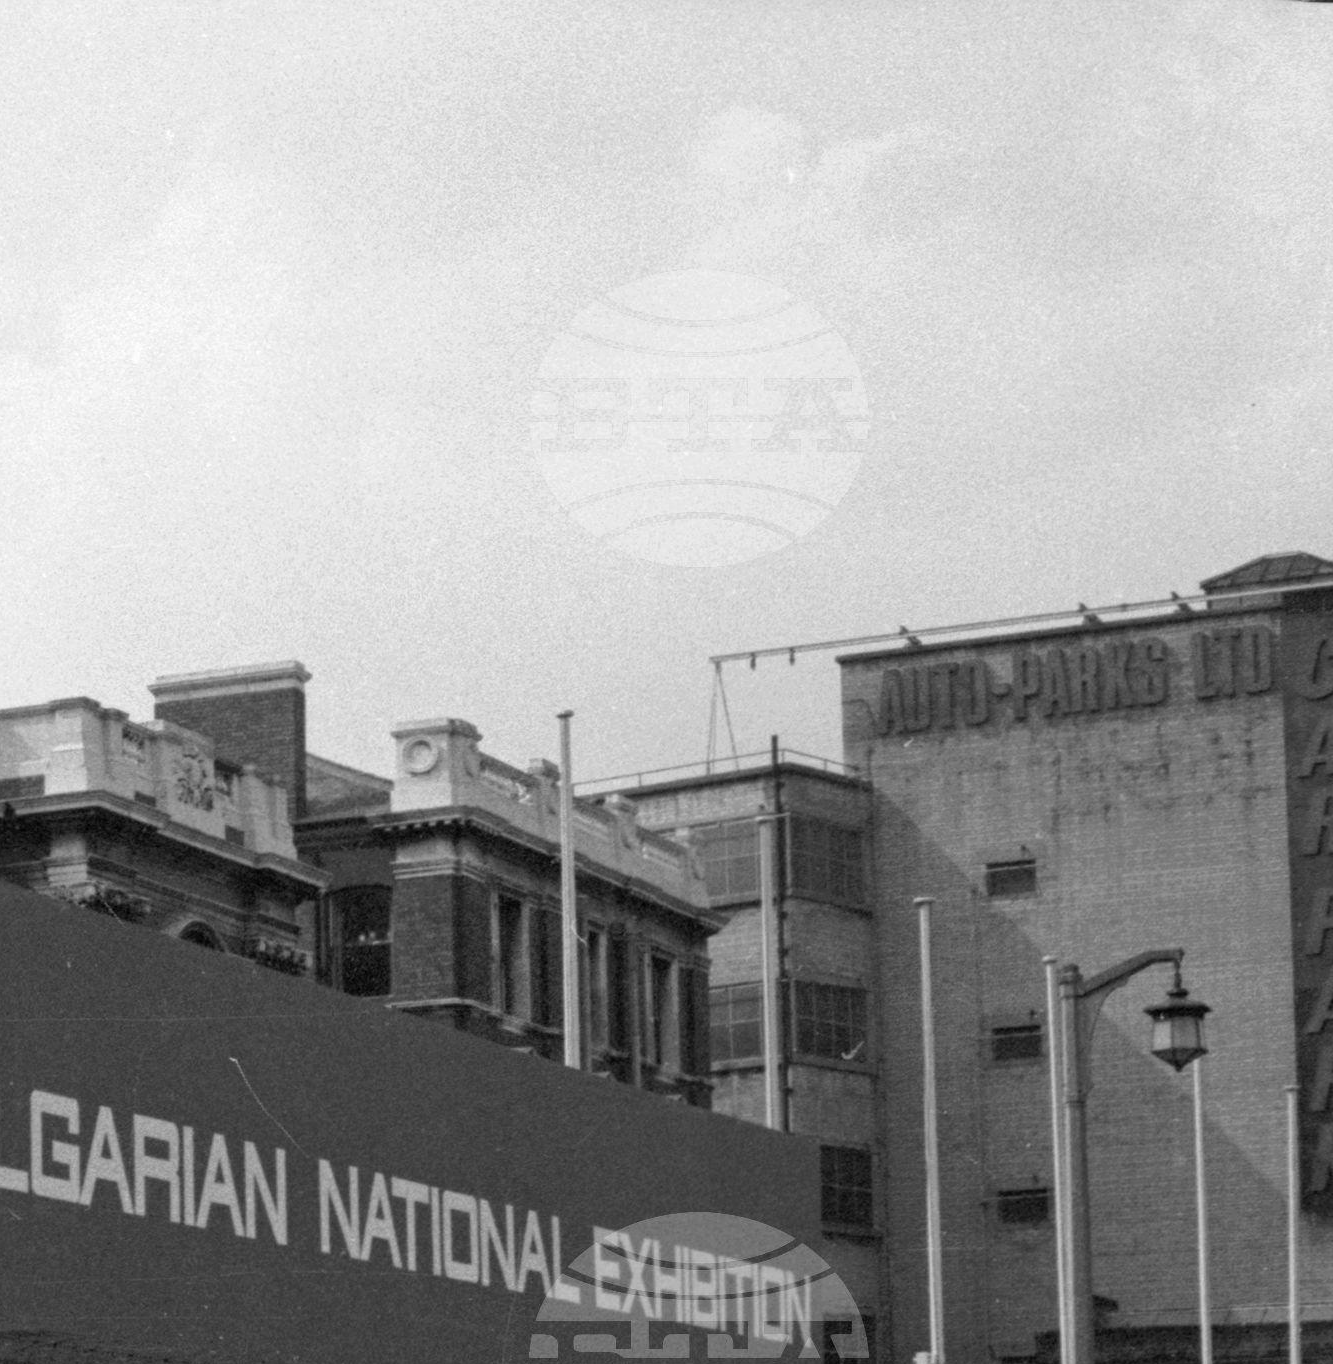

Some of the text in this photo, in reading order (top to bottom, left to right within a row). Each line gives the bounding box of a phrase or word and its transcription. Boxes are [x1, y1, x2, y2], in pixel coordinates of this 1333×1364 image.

[876, 625, 1277, 737] AUTO-PARKS LTD
[319, 1158, 581, 1303] NATIONAL
[593, 1225, 812, 1348] EXHIBITION
